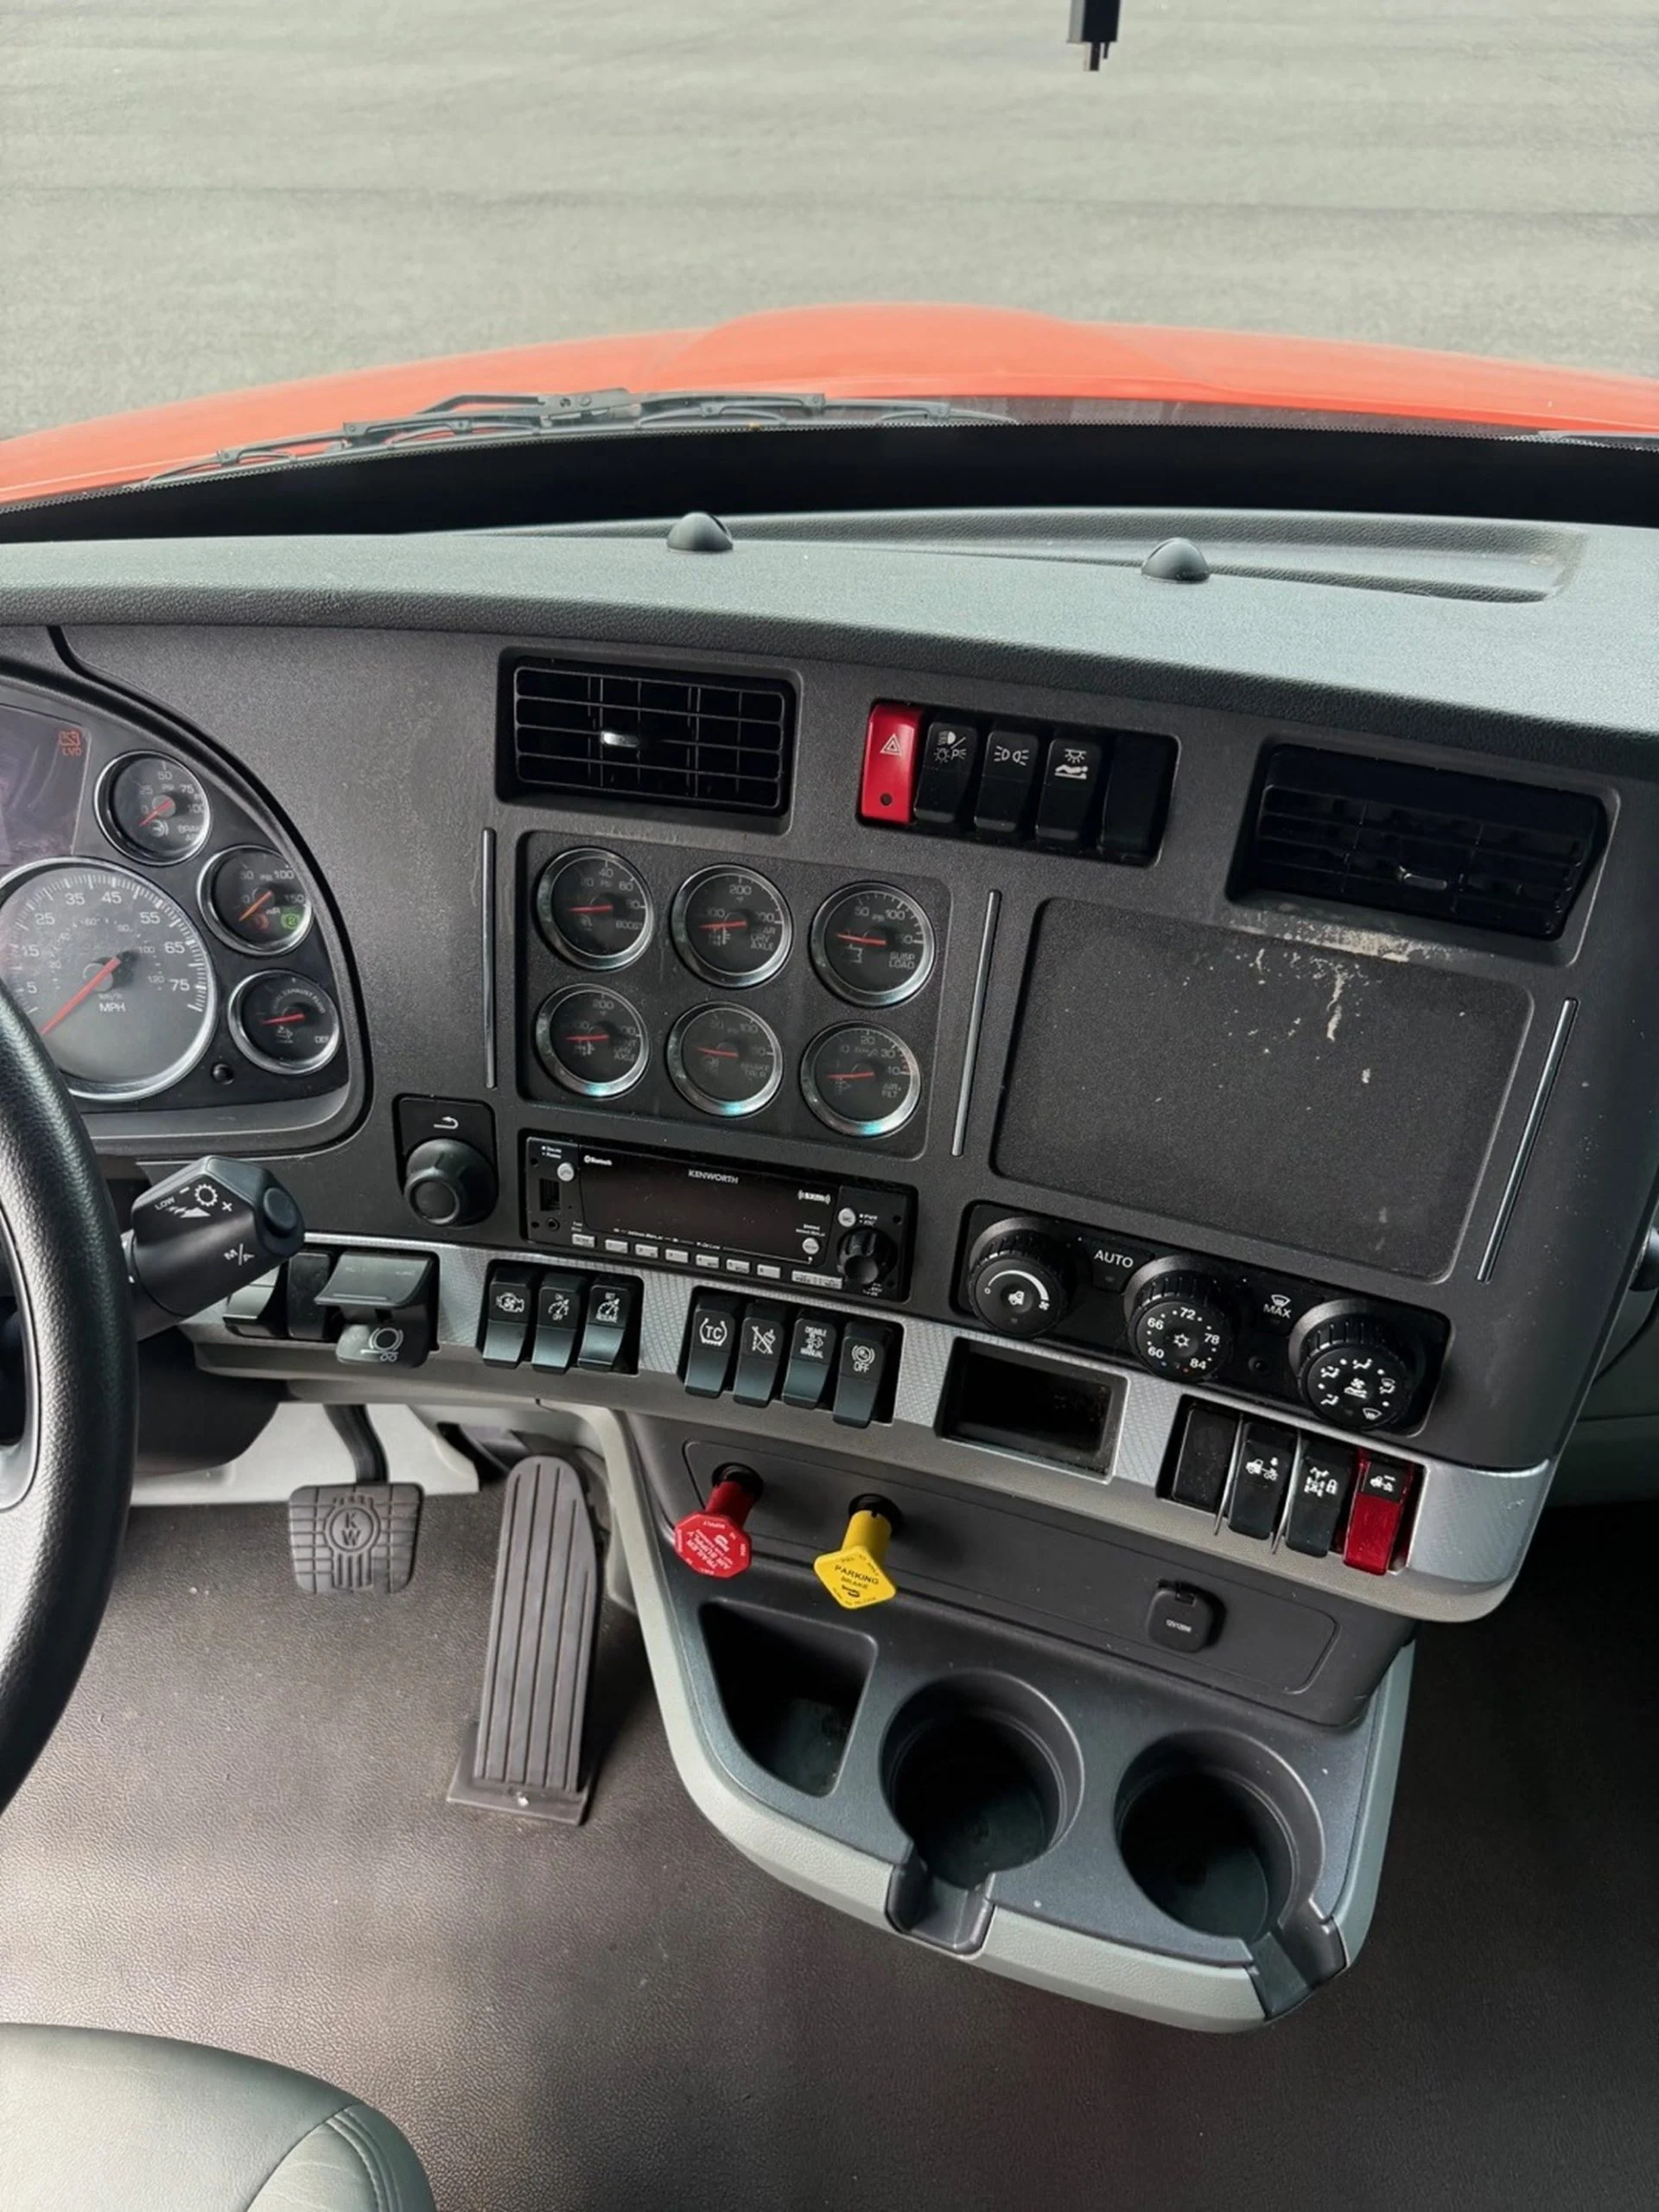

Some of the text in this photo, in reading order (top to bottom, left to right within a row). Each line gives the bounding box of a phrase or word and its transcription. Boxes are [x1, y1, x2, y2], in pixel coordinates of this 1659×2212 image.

[273, 870, 295, 880] 100
[729, 885, 752, 895] 200
[65, 892, 85, 906] 35
[102, 892, 122, 904] 45
[35, 912, 55, 925] 25
[140, 912, 160, 924] 55
[886, 909, 906, 920] 100
[22, 944, 39, 957] 15
[164, 942, 186, 954] 65
[888, 960, 915, 969] LOAD
[27, 982, 37, 994] 5
[170, 980, 190, 991] 75
[99, 1002, 126, 1013] MPH
[689, 1169, 739, 1185] KENWORTH
[155, 1197, 175, 1211] LOW
[1094, 1249, 1134, 1268] AUTO
[1180, 1306, 1196, 1320] 72
[1263, 1303, 1291, 1319] MAX
[1147, 1318, 1164, 1330] 66
[706, 1326, 721, 1339] TC
[1205, 1332, 1220, 1345] 78
[1147, 1346, 1164, 1358] 60
[854, 1363, 869, 1373] OFF
[1190, 1358, 1206, 1370] 84
[835, 1564, 879, 1585] PARKING
[841, 1576, 868, 1590] BRAKE
